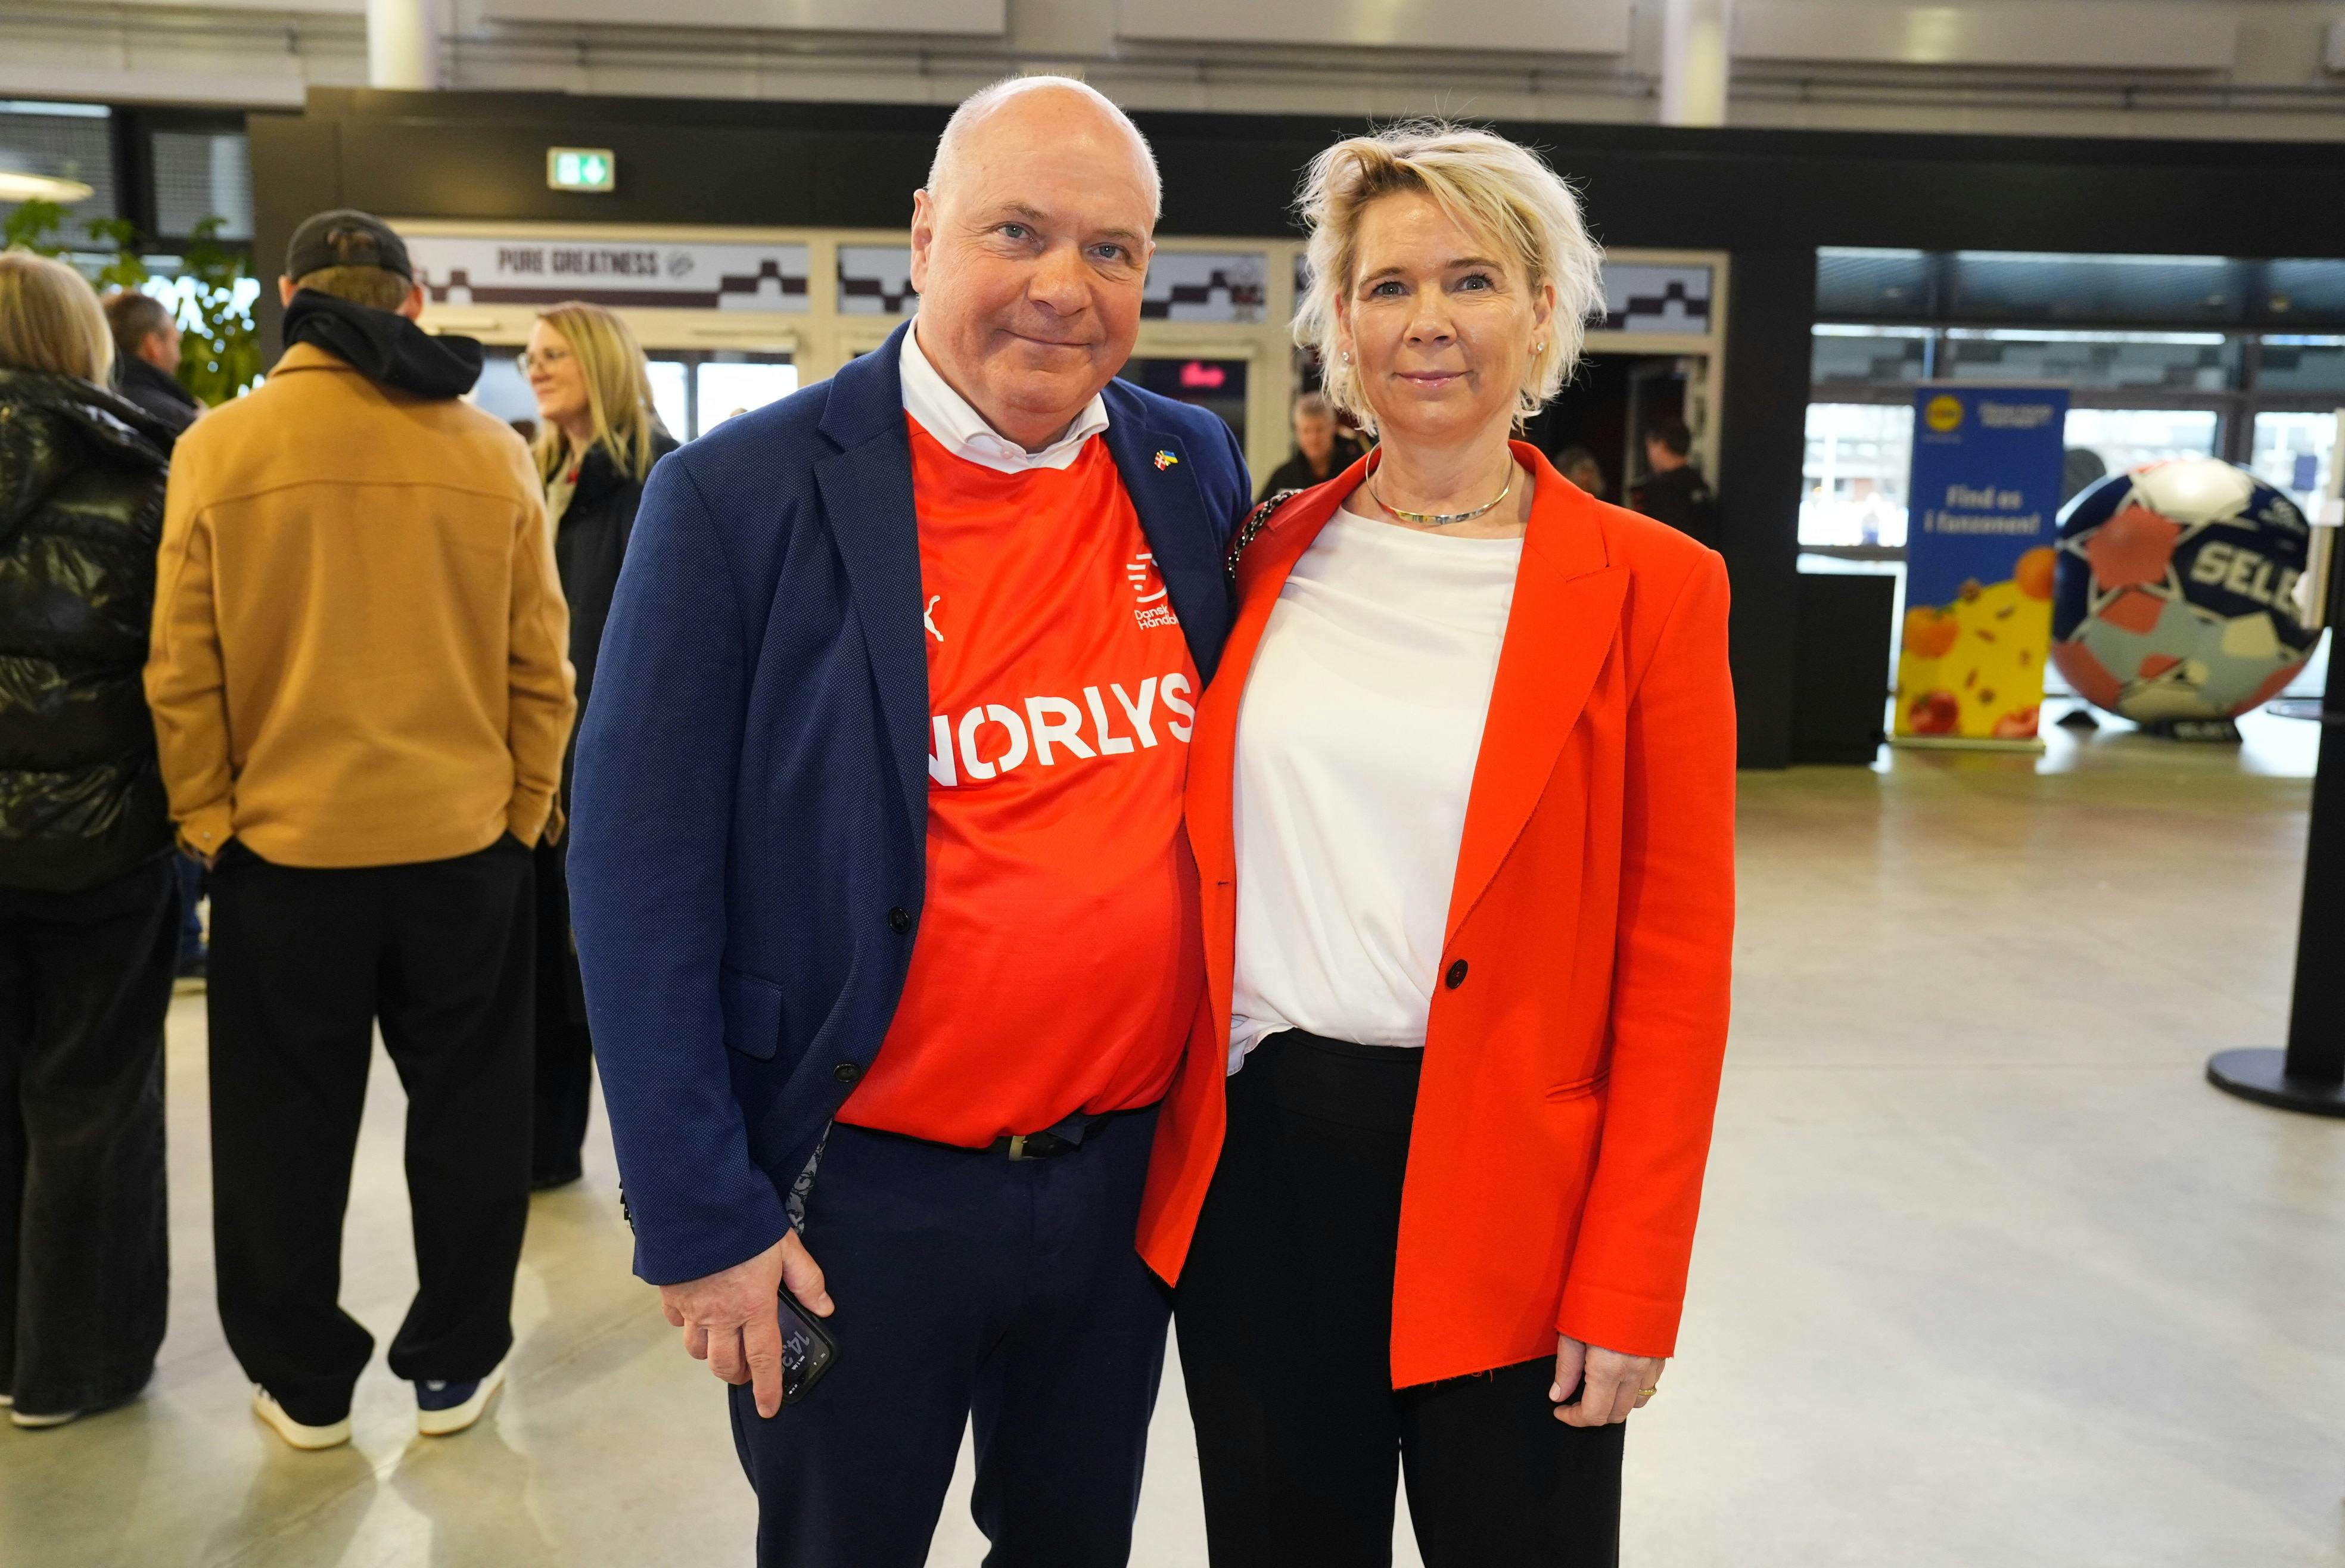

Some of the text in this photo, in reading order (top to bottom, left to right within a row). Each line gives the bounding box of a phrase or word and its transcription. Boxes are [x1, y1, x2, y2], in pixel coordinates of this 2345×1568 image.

[498, 248, 660, 278] PURE GREATNESS
[2190, 541, 2302, 618] SELE
[1134, 603, 1169, 621] Dansk
[1137, 613, 1179, 630] Håndbol
